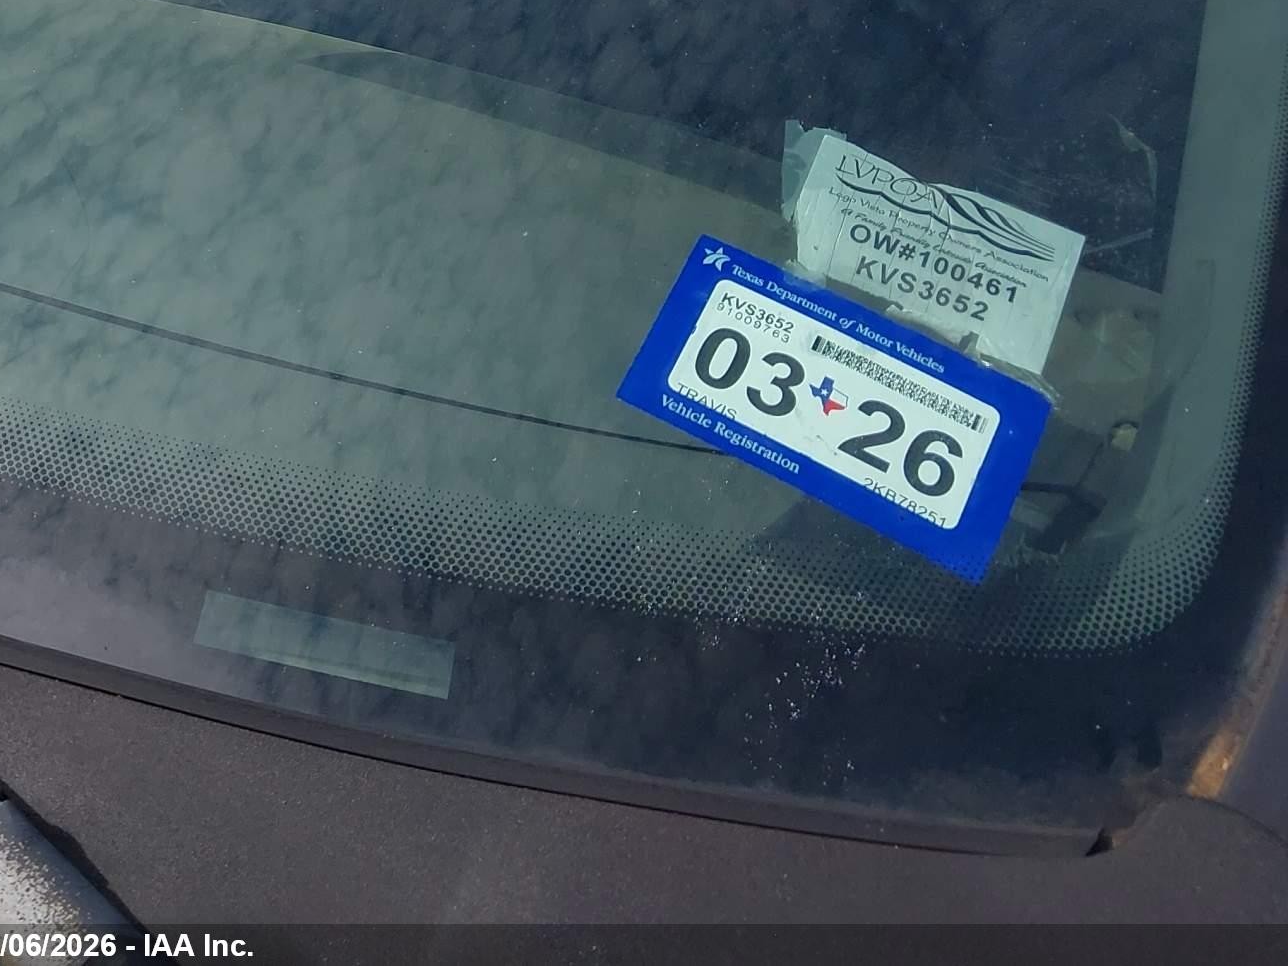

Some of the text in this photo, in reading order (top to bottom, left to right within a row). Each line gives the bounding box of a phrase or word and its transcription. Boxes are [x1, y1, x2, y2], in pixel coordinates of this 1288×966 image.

[835, 154, 939, 210] LVPOA
[829, 186, 1049, 282] Lago Vista Property Owners Association
[849, 223, 1018, 304] OW#100461
[716, 301, 791, 344] 91009763
[720, 291, 795, 334] KVS3652
[732, 263, 946, 375] Texas Department of Motor Vehicles
[855, 255, 989, 322] KVS3652
[661, 393, 802, 475] Vehicle Registration
[678, 382, 738, 421] TRAVIS
[694, 326, 964, 498] 03 26
